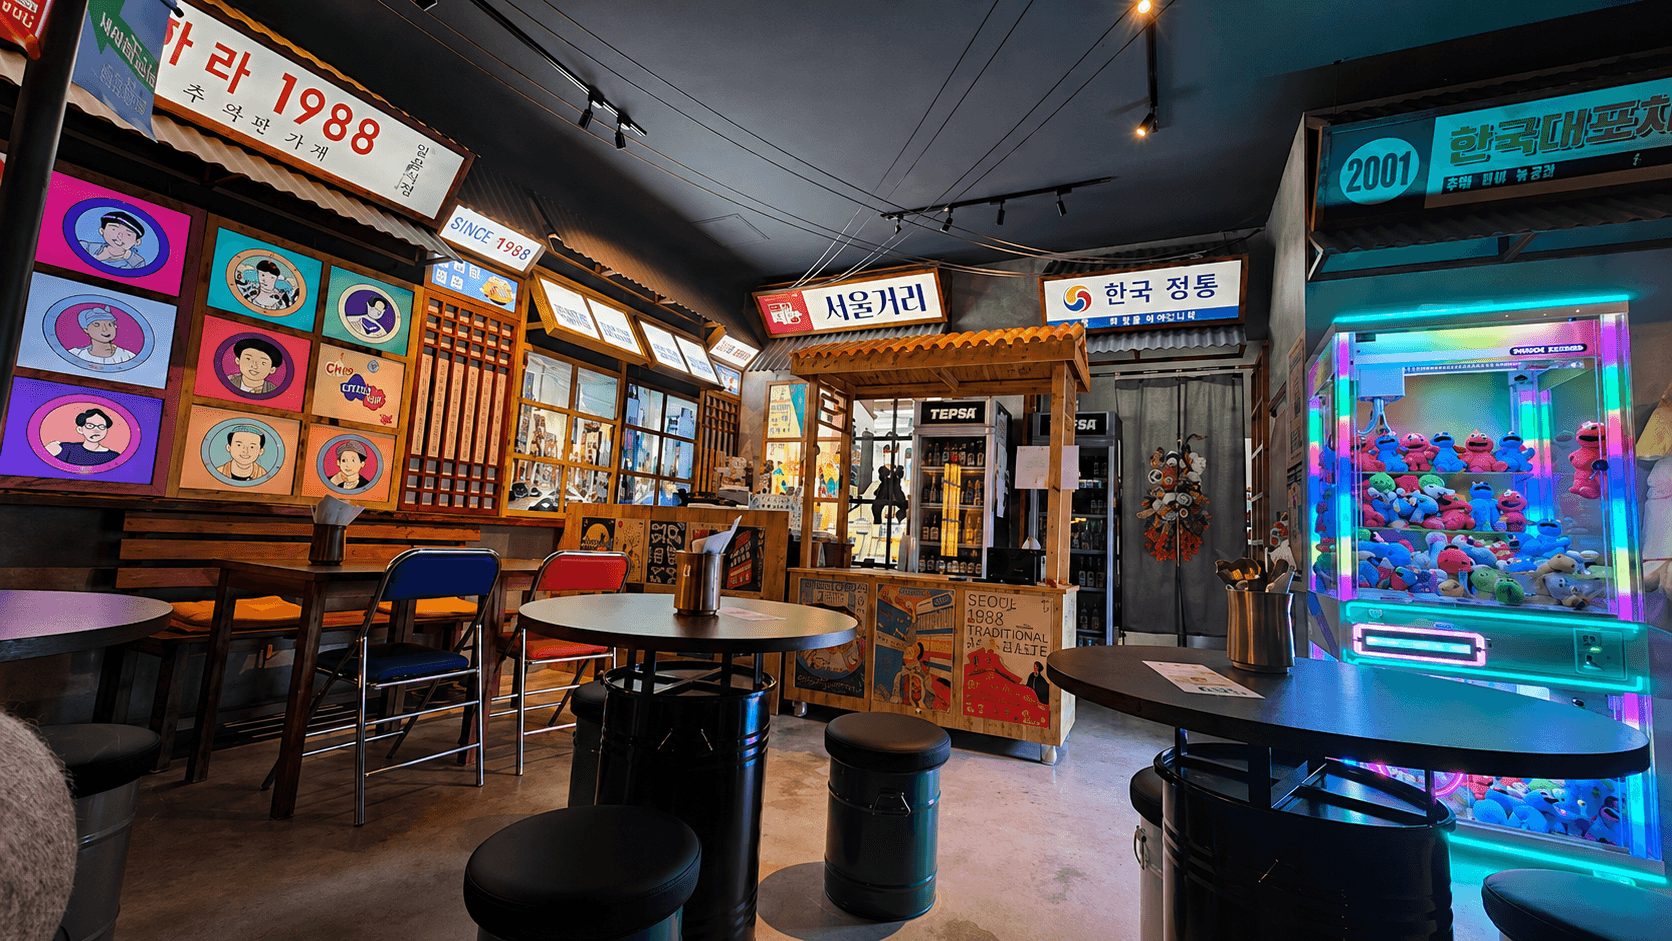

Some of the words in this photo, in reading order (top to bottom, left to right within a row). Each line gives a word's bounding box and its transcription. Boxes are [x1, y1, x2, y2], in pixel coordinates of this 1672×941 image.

[273, 72, 380, 155] 1988
[1345, 151, 1412, 193] 2001
[450, 216, 495, 245] SINCE
[496, 237, 531, 261] 1988
[826, 283, 927, 321] 서울거리
[1104, 280, 1153, 306] 한국
[1166, 273, 1219, 301] 정통
[930, 407, 977, 420] TEPSA
[967, 624, 1048, 643] TRADITIONAL
[968, 609, 1004, 626] 1988
